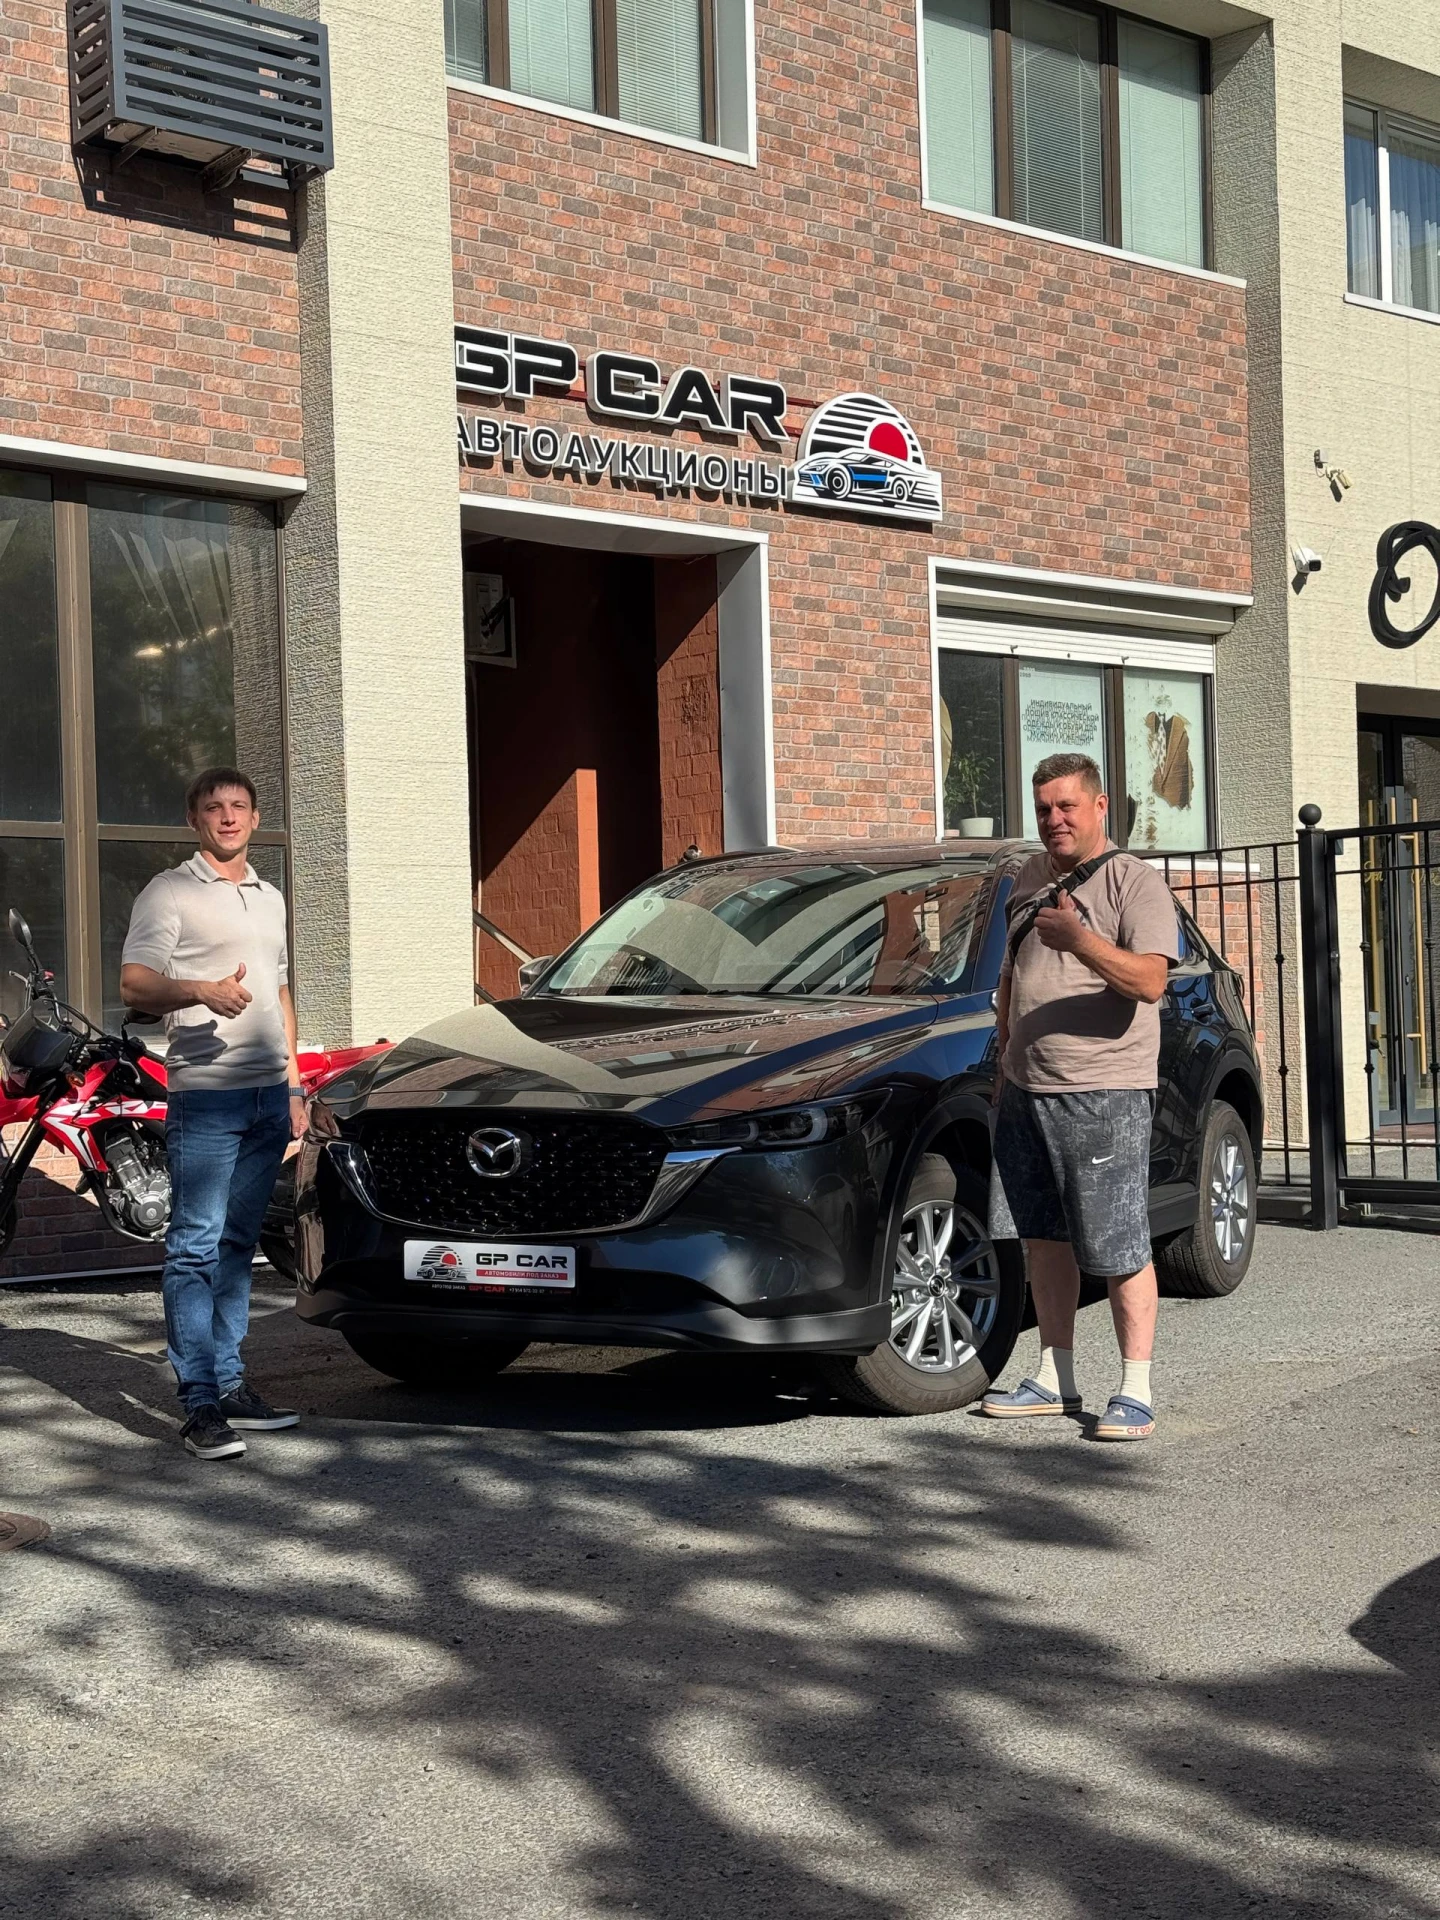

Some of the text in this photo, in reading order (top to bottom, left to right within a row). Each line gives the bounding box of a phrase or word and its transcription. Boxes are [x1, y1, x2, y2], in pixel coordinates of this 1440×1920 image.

[592, 350, 787, 442] CAR
[1030, 699, 1092, 711] ИНДИВИДУАЛЬНЫЙ
[476, 1252, 568, 1269] GP CAR
[484, 1270, 526, 1278] АВТОМОБИЛИ
[484, 1285, 505, 1293] CAR
